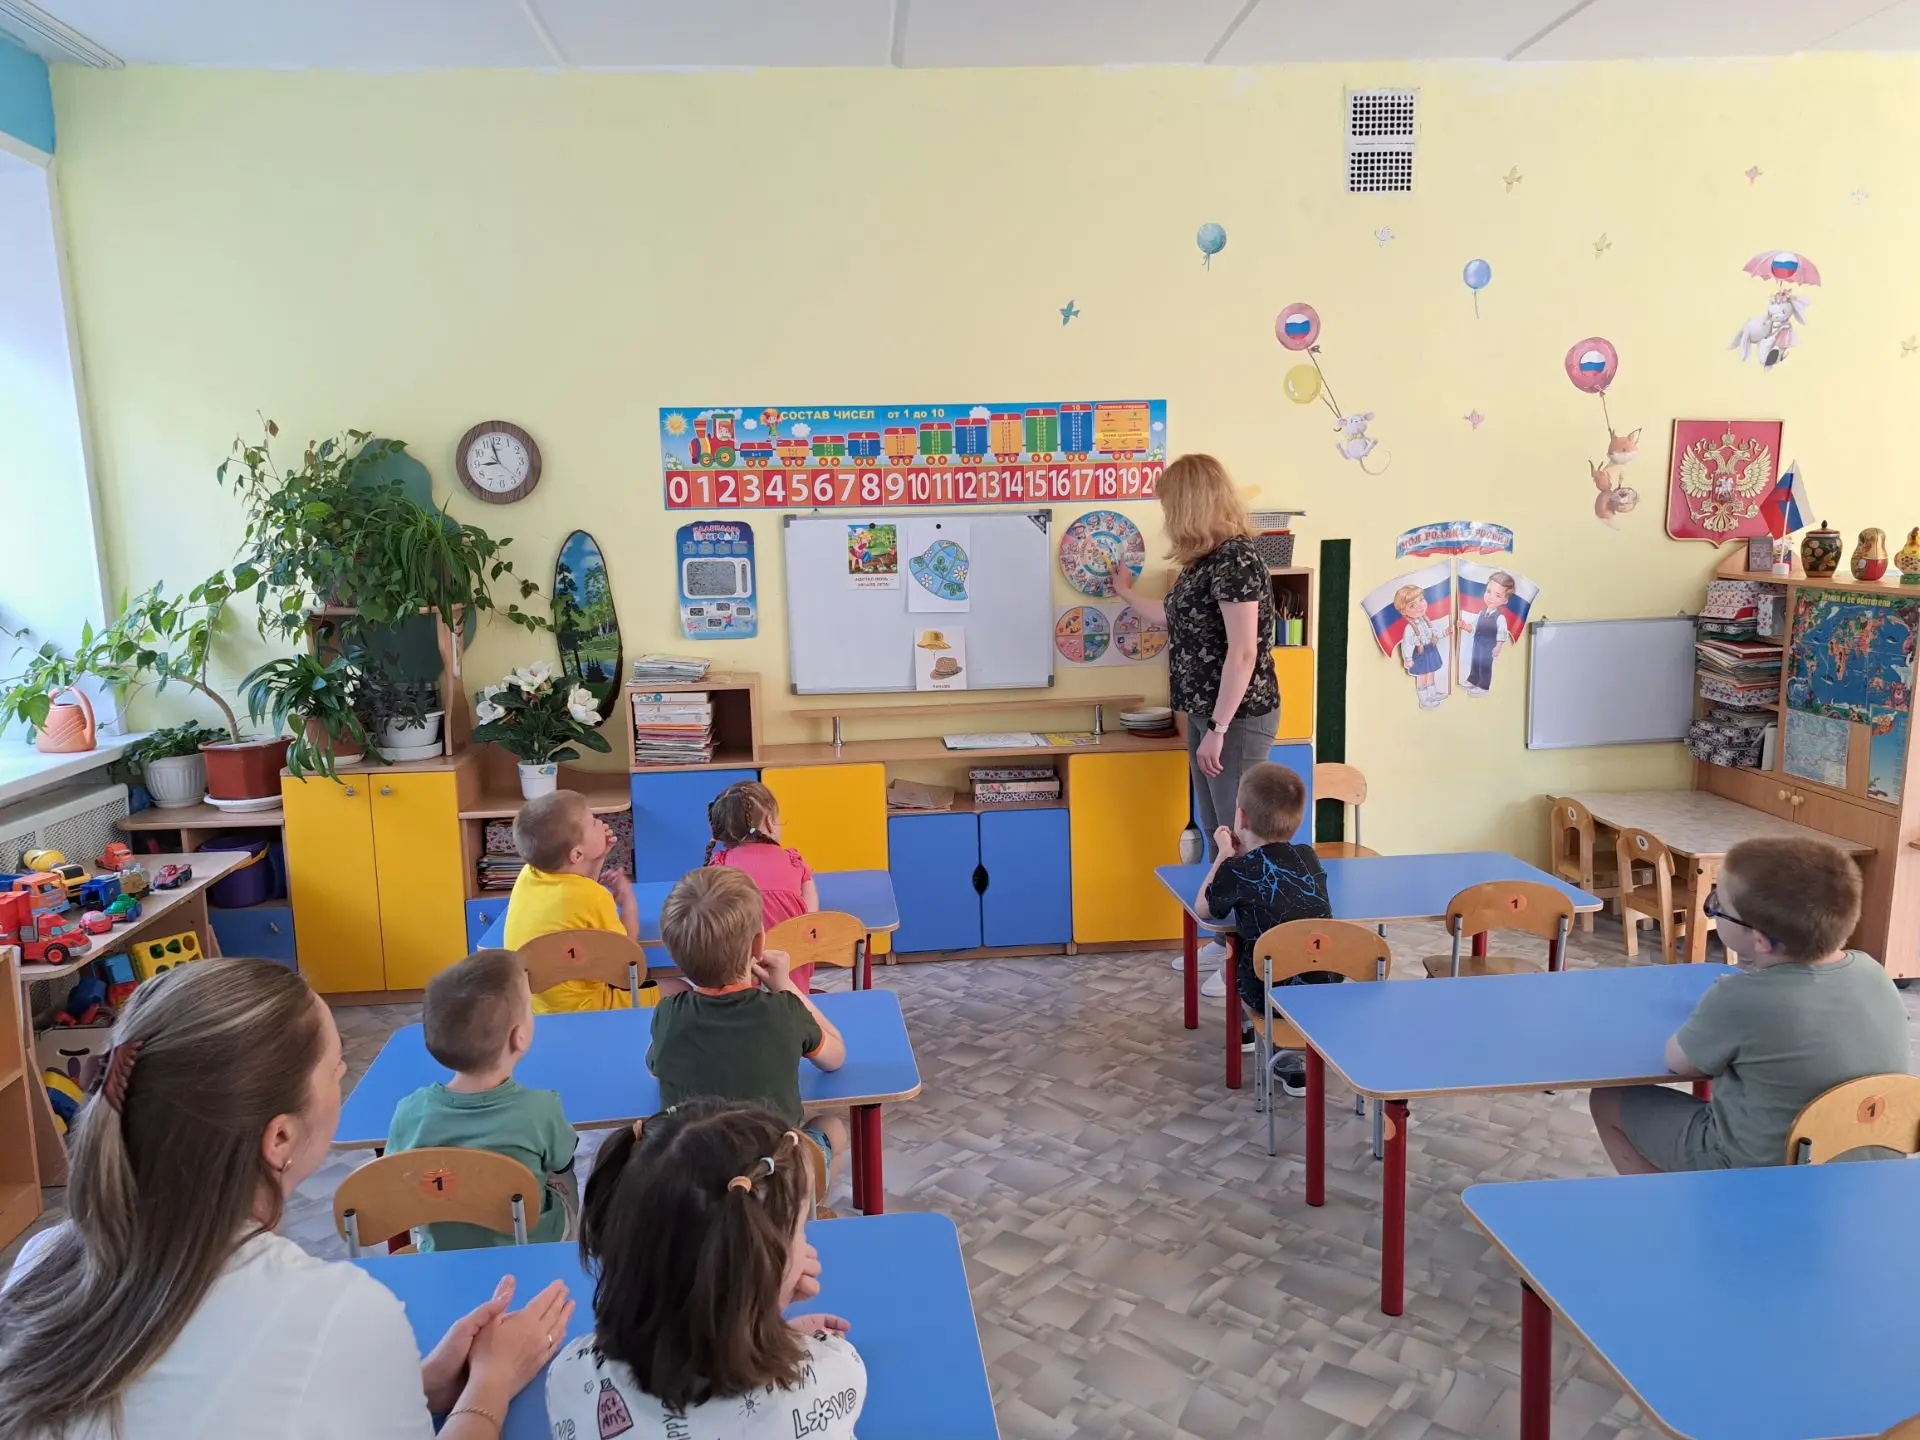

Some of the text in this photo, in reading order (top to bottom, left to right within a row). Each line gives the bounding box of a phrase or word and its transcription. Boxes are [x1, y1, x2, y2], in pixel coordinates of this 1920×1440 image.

[781, 408, 944, 421] СОСТАВ ЧИСЕЛ от 1 до 10
[482, 440, 489, 448] 11
[492, 436, 500, 446] 12
[506, 439, 510, 447] 1
[475, 449, 484, 458] 10
[514, 446, 520, 454] 2
[518, 457, 524, 466] 3
[478, 470, 484, 479] 8
[487, 478, 493, 487] 7
[669, 476, 688, 504] 0
[696, 476, 710, 503] 1
[718, 476, 737, 503] 2
[742, 475, 761, 503] 3
[765, 475, 786, 502] 4
[791, 474, 808, 502] 5
[814, 474, 833, 502] 6
[838, 474, 856, 501] 7
[861, 473, 880, 501] 8
[886, 472, 904, 500] 9
[909, 472, 930, 500] 10
[932, 472, 952, 500] 11
[955, 472, 977, 499] 12
[978, 471, 1000, 498] 13
[1002, 470, 1024, 498] 14
[1026, 470, 1047, 498] 15
[1049, 469, 1070, 497] 16
[1072, 469, 1095, 496] 17
[1096, 468, 1117, 495] 18
[1119, 466, 1140, 494] 19
[1511, 899, 1518, 909] 1
[810, 928, 817, 939] 1
[1313, 939, 1320, 949] 1
[568, 948, 575, 959] 1
[1867, 1103, 1876, 1117] 1
[432, 1177, 443, 1191] 1
[602, 1410, 626, 1430] SUN
